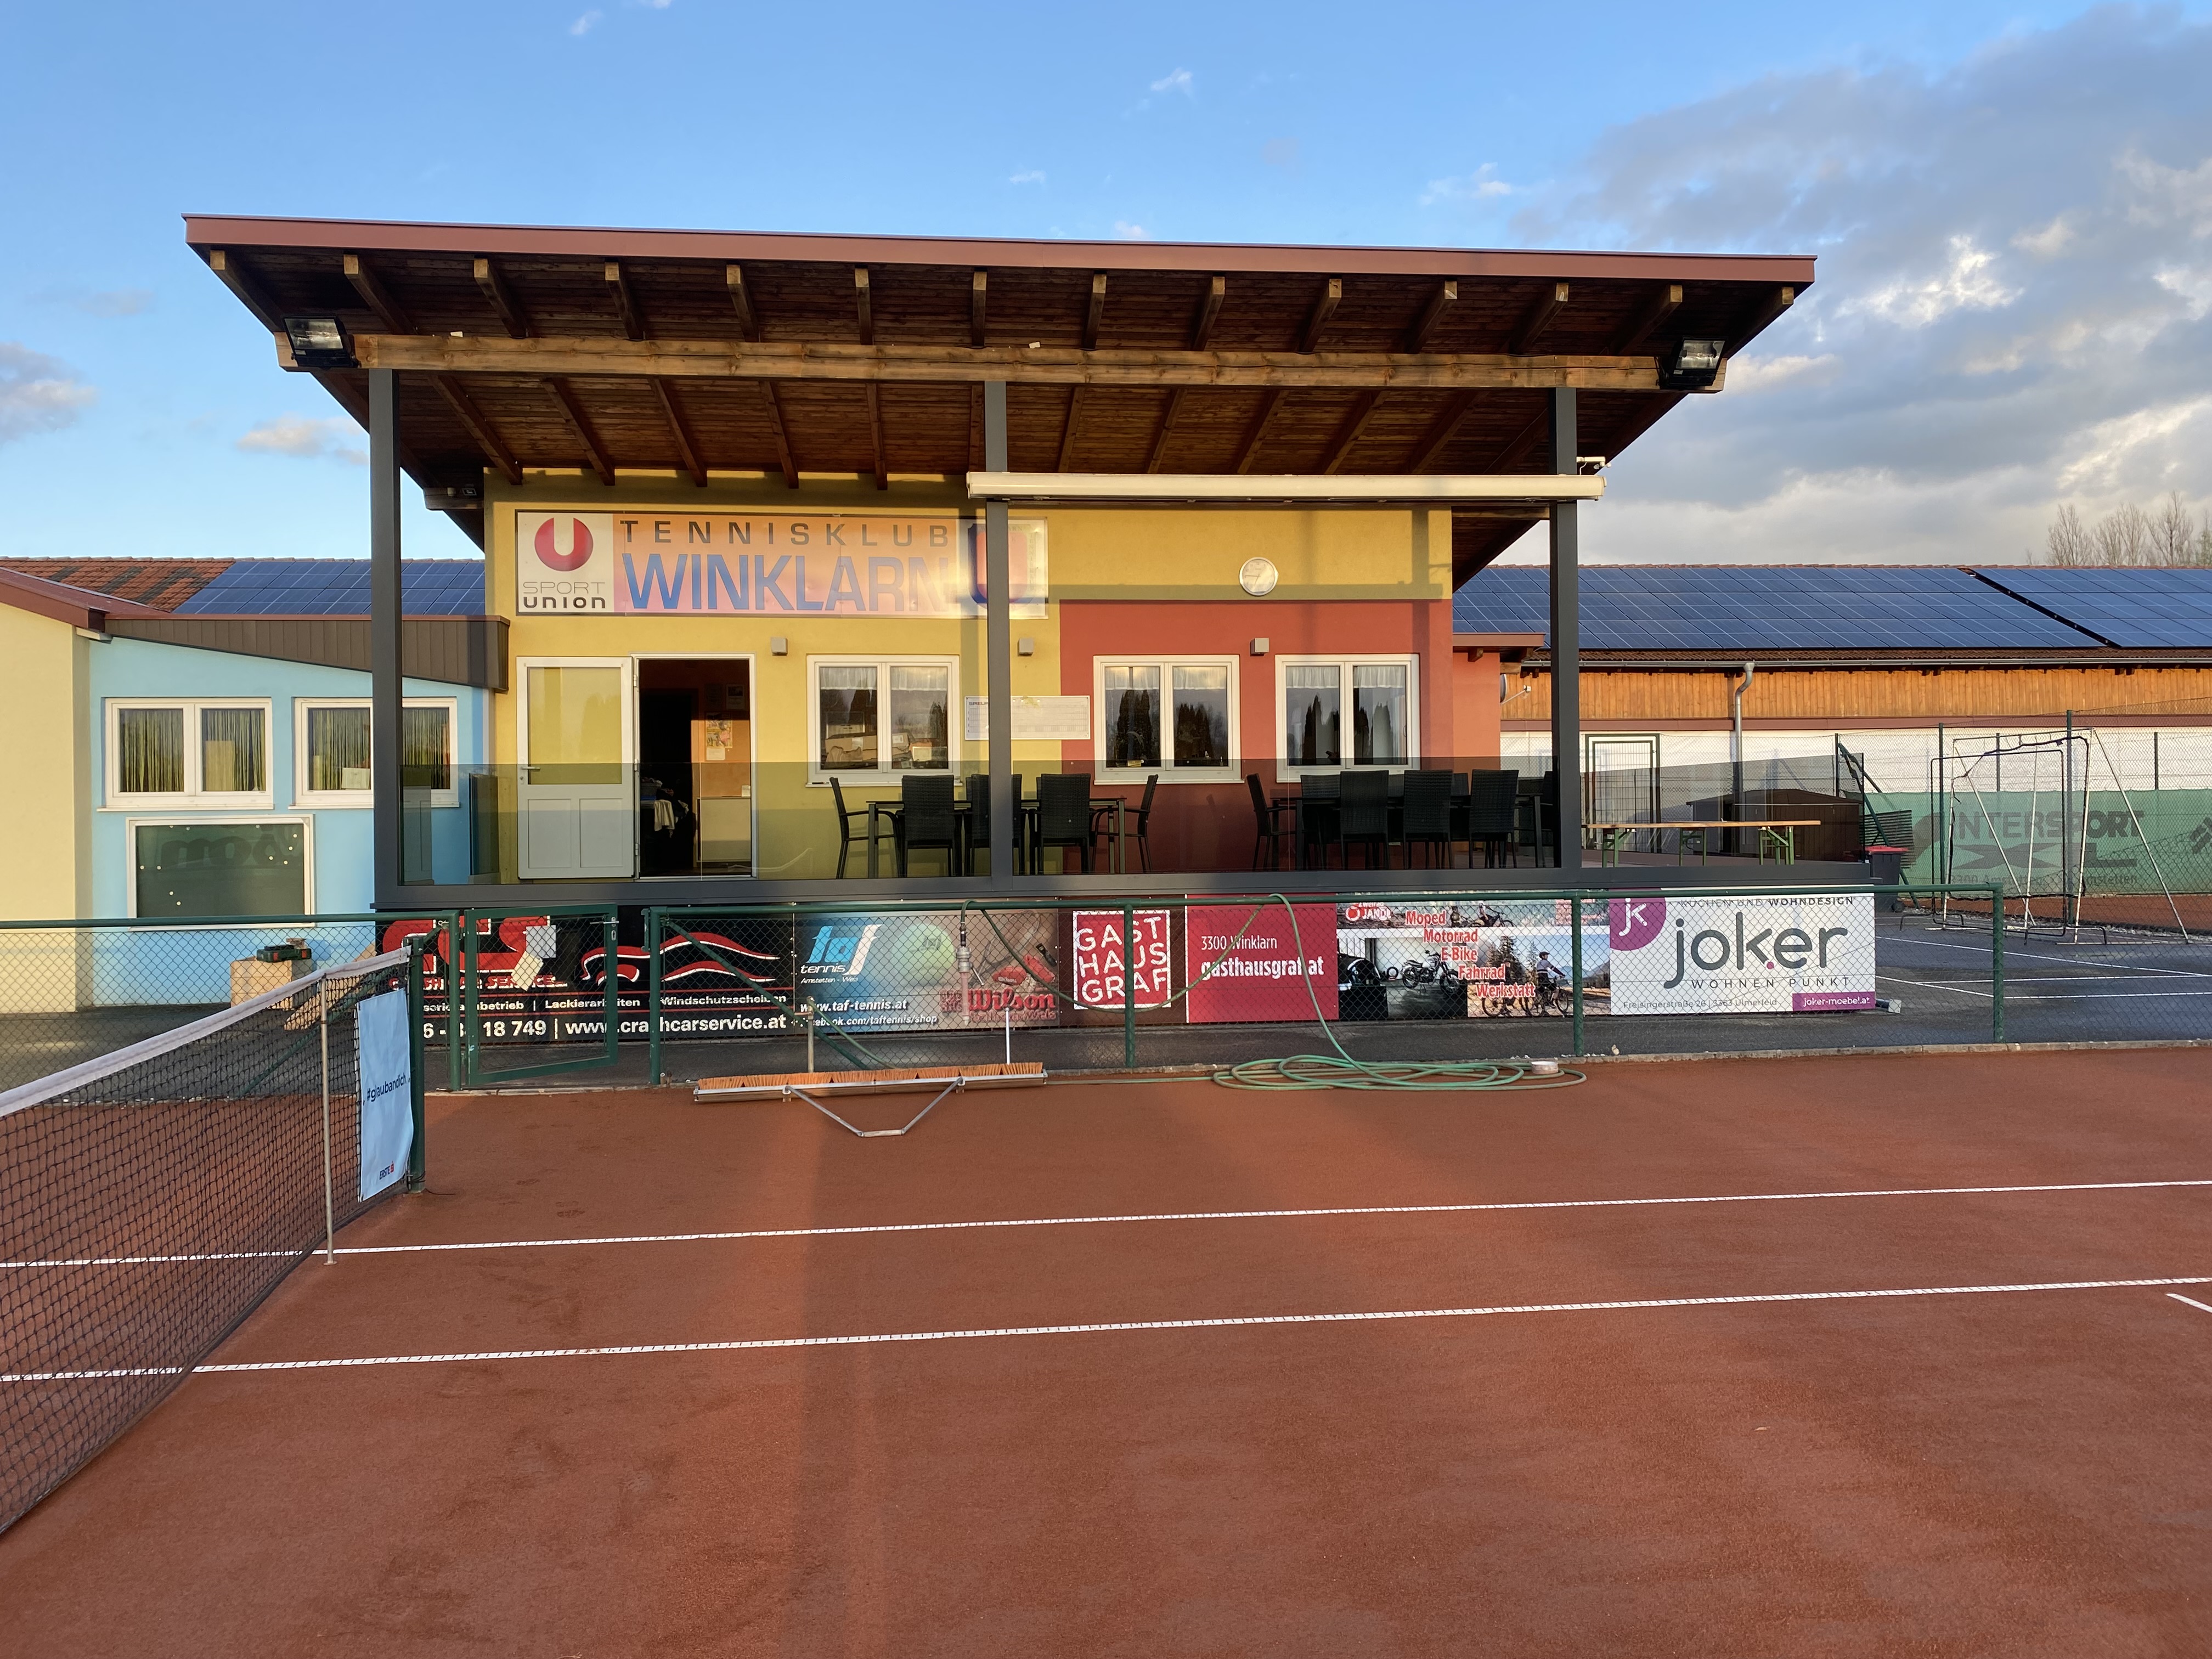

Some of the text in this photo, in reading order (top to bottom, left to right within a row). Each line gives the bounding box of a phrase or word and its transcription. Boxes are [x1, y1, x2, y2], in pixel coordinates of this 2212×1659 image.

[620, 520, 949, 547] TENNISKLUB
[523, 582, 605, 594] SPORT
[622, 552, 949, 612] WINKLARN
[1769, 897, 1854, 906] WOHNDESIGN
[1406, 910, 1446, 928] Moped
[1201, 935, 1278, 950] 3300 Winklarn
[1423, 928, 1478, 943] Motorrad
[1441, 946, 1477, 961] E-Bike
[1663, 912, 1848, 989] joker
[800, 963, 846, 974] tennis
[1201, 956, 1324, 980] gasthausgrafat
[1459, 964, 1505, 980] Fahrrad
[1477, 983, 1536, 997] Werkstatt
[1691, 977, 1849, 989] WOHNEN PUNKT
[968, 987, 1056, 1011] Wilson
[1735, 998, 1778, 1007] Ulmerfeld
[1803, 996, 1870, 1007] joker-moebel.at
[483, 1021, 505, 1037] 18
[510, 1019, 546, 1036] 749
[565, 1014, 786, 1035] www.crahcarservice.at
[366, 1072, 407, 1102] #glaubandich
